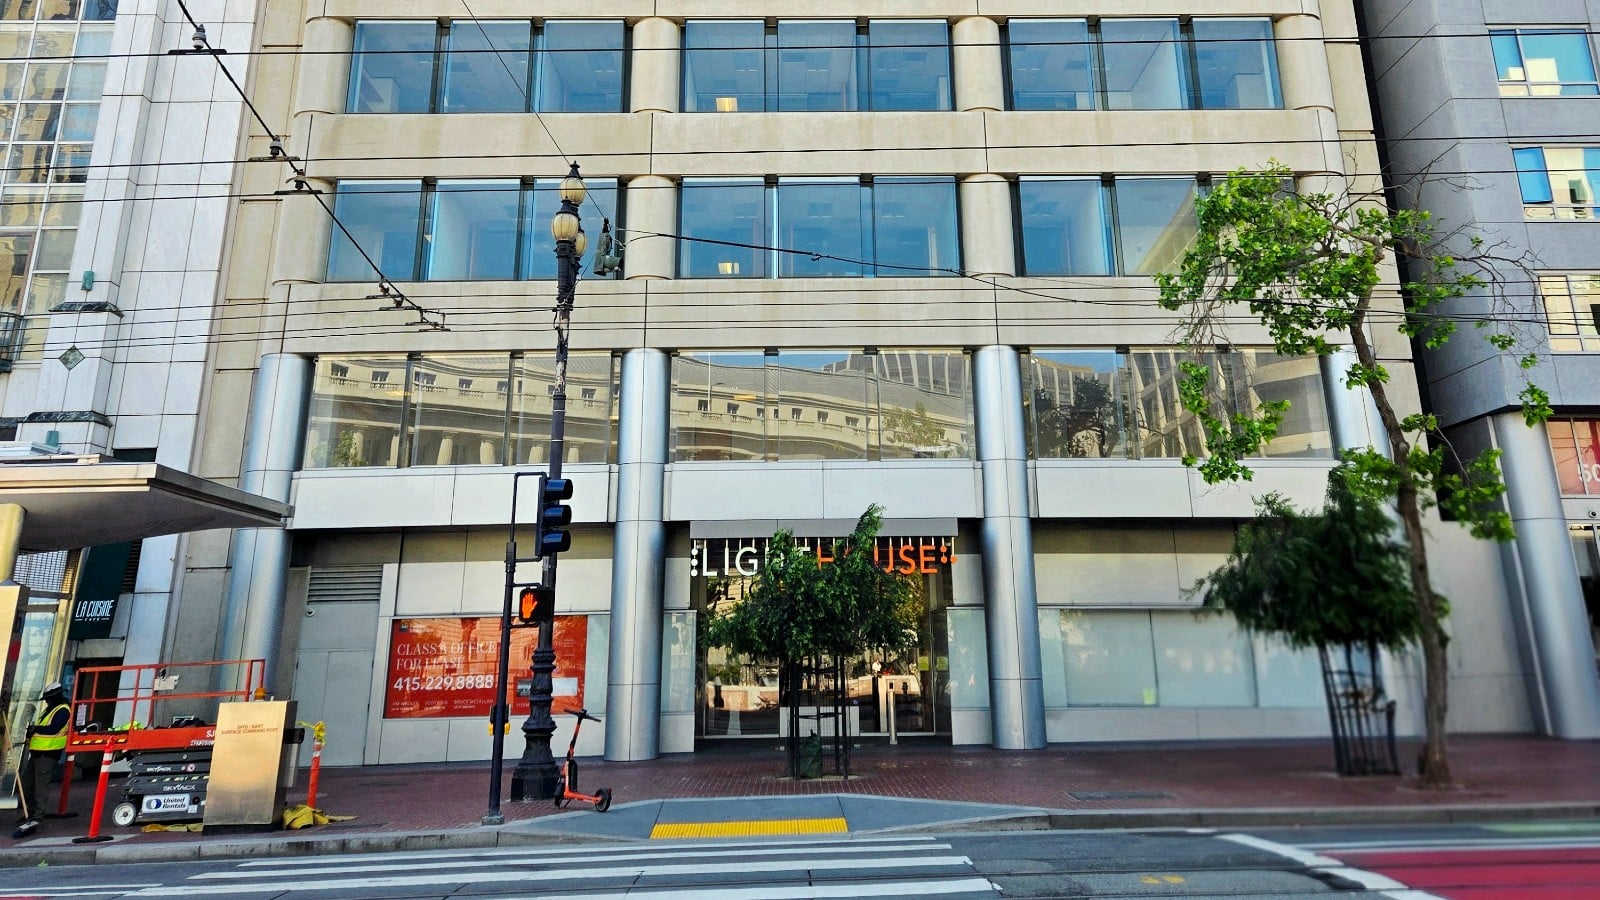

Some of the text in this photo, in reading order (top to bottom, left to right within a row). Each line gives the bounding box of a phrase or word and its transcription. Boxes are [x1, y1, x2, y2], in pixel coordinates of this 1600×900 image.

[75, 600, 115, 617] LA CUISINE
[397, 641, 496, 656] CLASS A OFFICE
[396, 656, 465, 671] FOR LEASE
[394, 674, 494, 691] 415.229.8888
